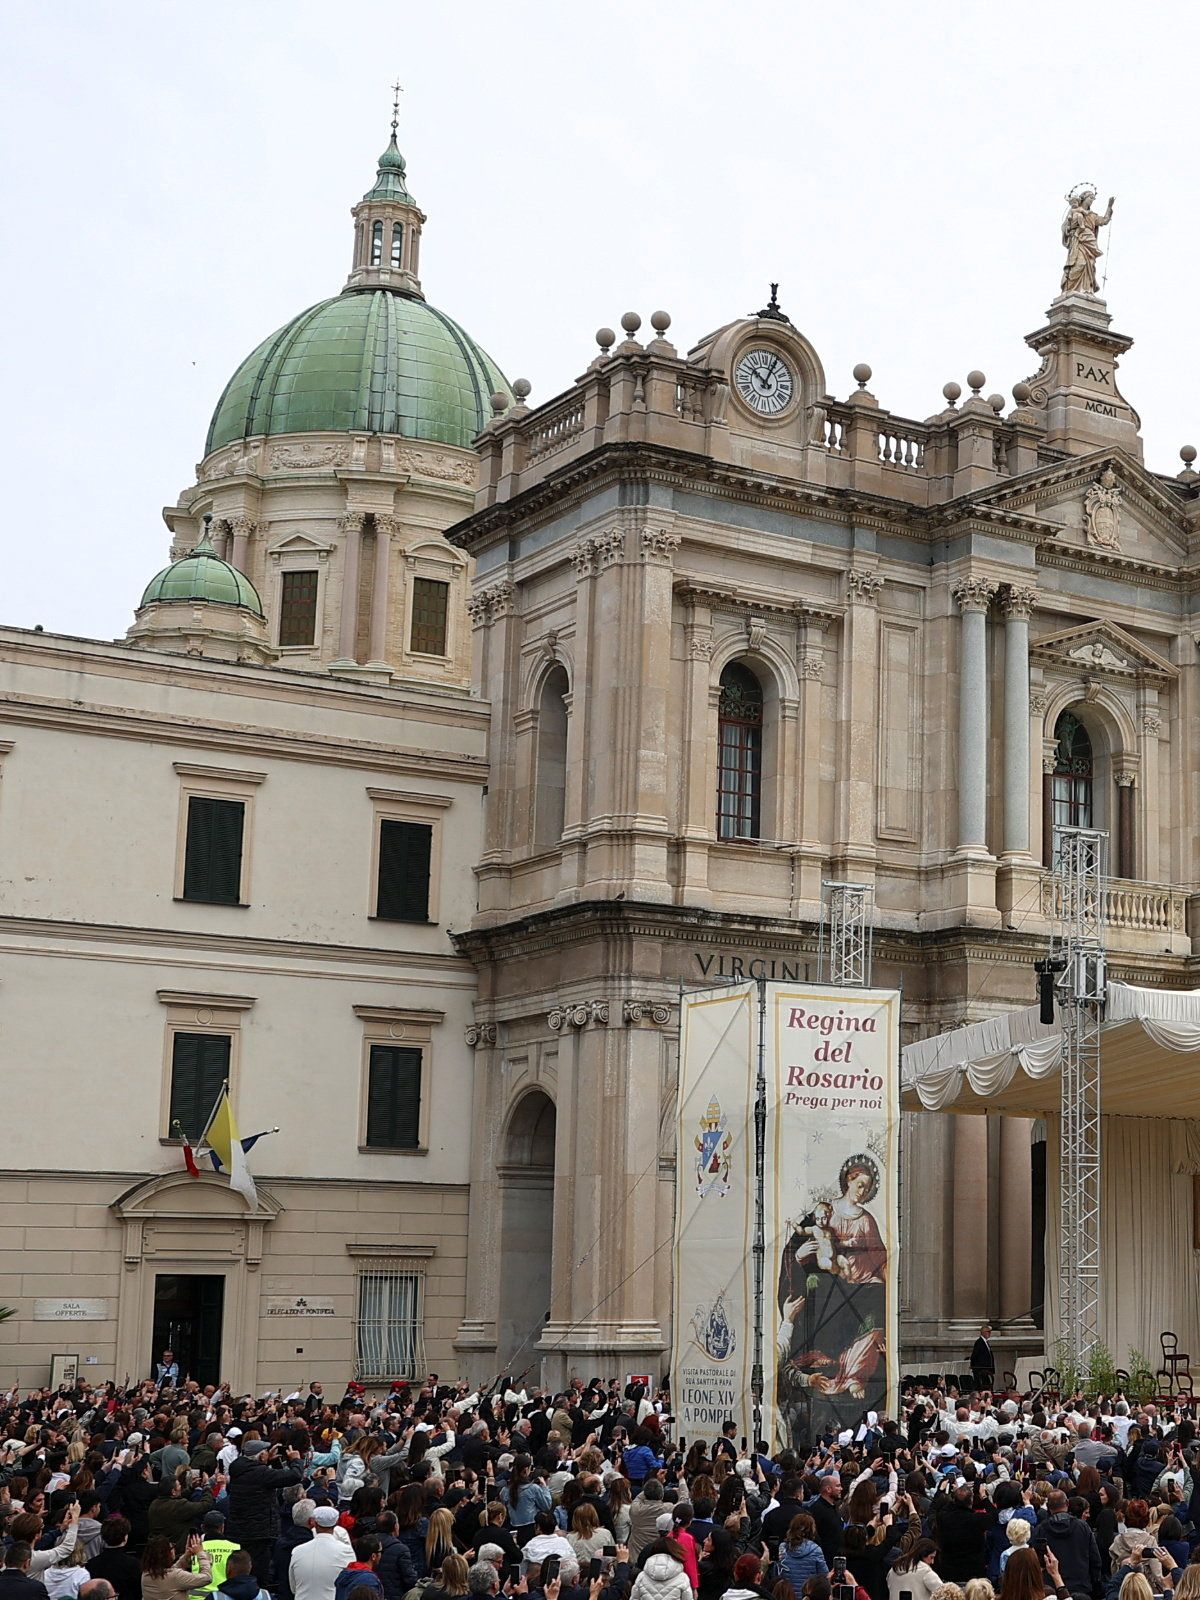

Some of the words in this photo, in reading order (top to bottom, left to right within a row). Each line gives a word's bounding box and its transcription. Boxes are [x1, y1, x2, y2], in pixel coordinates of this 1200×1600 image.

[1077, 363, 1110, 385] PAX
[1085, 401, 1118, 418] MCMI
[695, 953, 810, 981] VIRGINI
[786, 1008, 876, 1036] Regina
[814, 1040, 852, 1063] del
[785, 1065, 884, 1091] Rosario
[785, 1092, 828, 1109] Prega
[829, 1097, 856, 1111] per
[859, 1096, 882, 1109] noi
[682, 1368, 699, 1376] VISITA
[700, 1368, 729, 1377] PASTORALE
[730, 1369, 736, 1377] DI
[682, 1388, 715, 1405] LEONE
[717, 1390, 736, 1406] XIV
[684, 1408, 690, 1422] A
[693, 1408, 733, 1424] POMPEI
